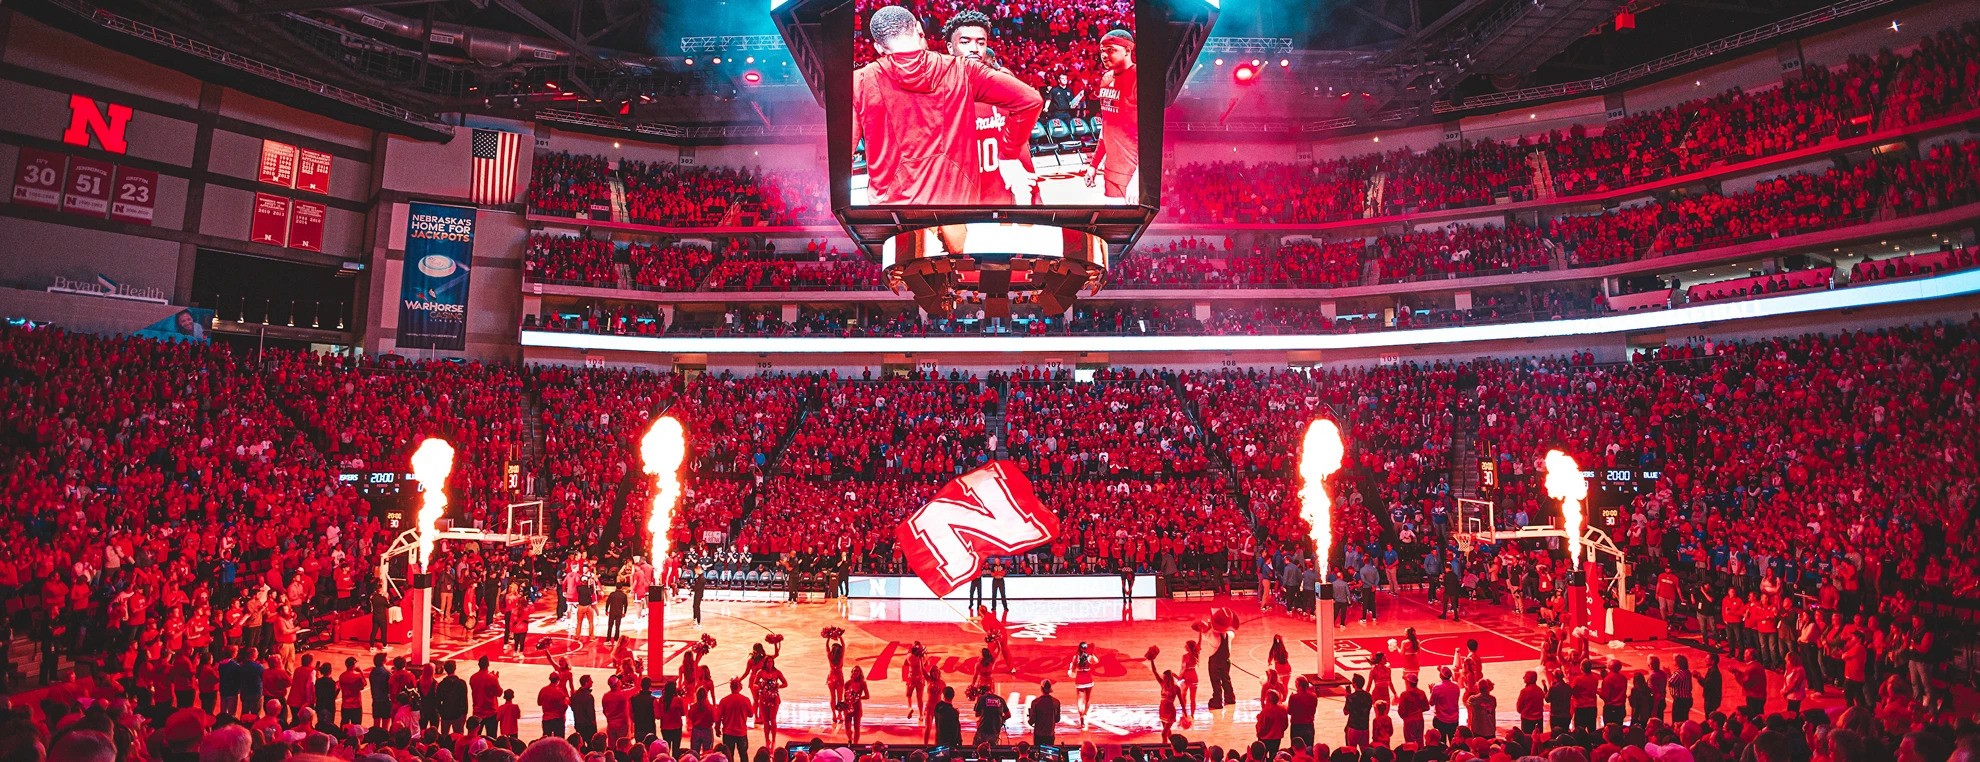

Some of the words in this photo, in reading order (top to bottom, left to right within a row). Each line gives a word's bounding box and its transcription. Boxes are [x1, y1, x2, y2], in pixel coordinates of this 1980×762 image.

[1782, 59, 1800, 70] 309
[1607, 110, 1623, 119] 308
[63, 93, 133, 154] N
[1445, 132, 1459, 140] 307
[24, 164, 56, 186] 30
[75, 173, 101, 195] 51
[15, 187, 27, 197] N
[120, 183, 149, 203] 23
[66, 196, 77, 206] N
[115, 203, 124, 213] N
[412, 214, 472, 226] NEBRASKA'S
[411, 222, 445, 232] HOME
[448, 225, 471, 234] FOR
[411, 230, 470, 243] JACKPOTS
[54, 276, 101, 293] Bryan
[119, 283, 164, 300] Health
[429, 311, 463, 320] CASINO
[1686, 334, 1705, 344] 110
[1382, 355, 1398, 363] 109
[757, 361, 772, 369] 105
[922, 361, 937, 369] 106
[370, 472, 395, 483] 20:00
[1483, 470, 1493, 485] 30
[1606, 470, 1631, 481] 20:00
[1643, 471, 1659, 479] BLUE
[508, 474, 518, 489] 30
[390, 519, 399, 528] 30
[907, 462, 1052, 587] N
[1605, 516, 1615, 525] 30
